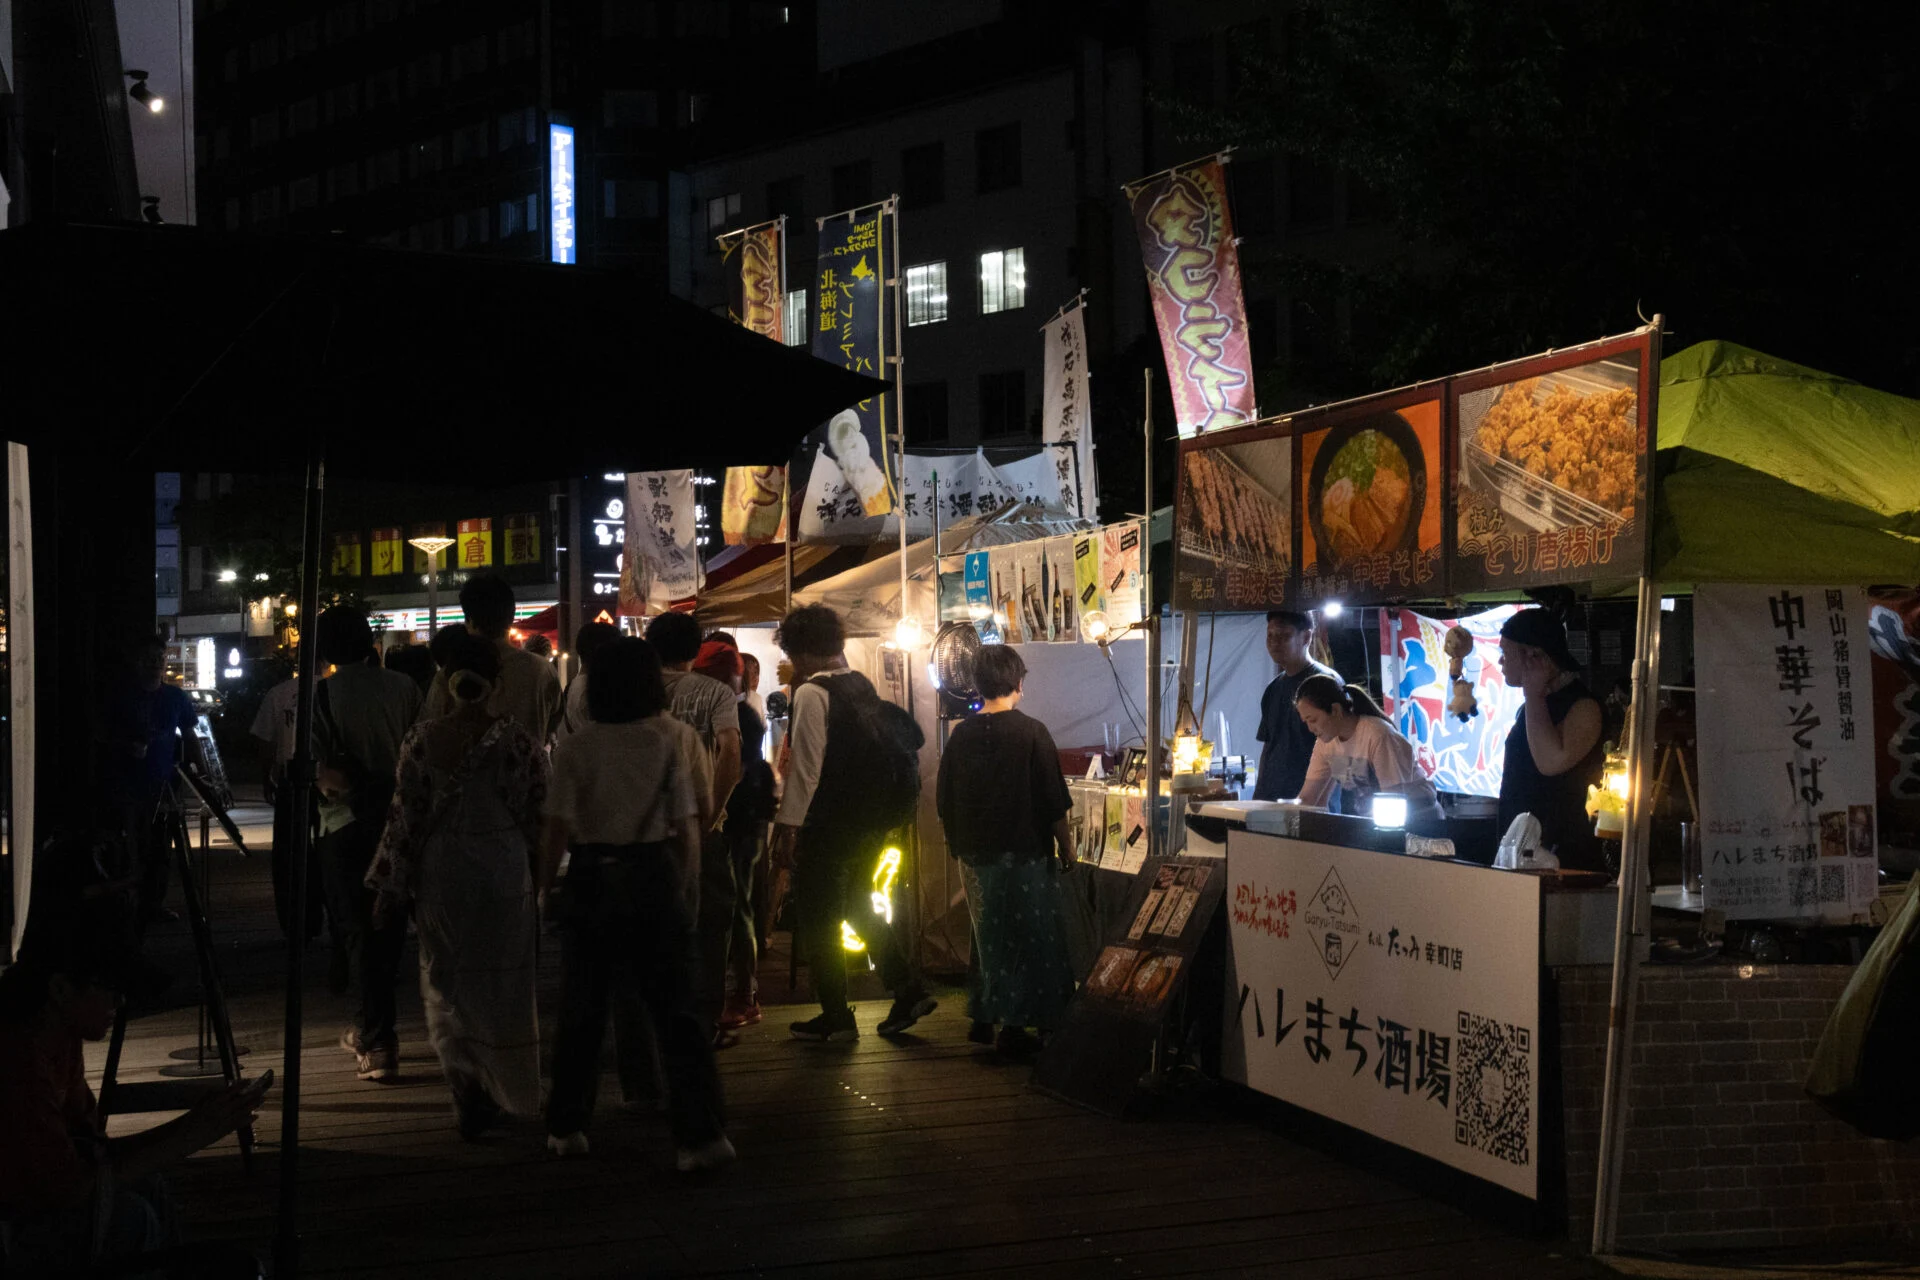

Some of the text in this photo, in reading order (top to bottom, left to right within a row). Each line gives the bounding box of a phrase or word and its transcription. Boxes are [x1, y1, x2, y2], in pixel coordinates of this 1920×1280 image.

[552, 131, 573, 264] アートネイチャー
[1469, 506, 1504, 537] 極み
[1484, 519, 1619, 576] とり唐揚げ
[1225, 566, 1287, 606] 串焼き
[1353, 548, 1434, 592] 中華そば
[1824, 588, 1855, 741] 岡山猪骨醤油
[1768, 589, 1827, 807] 中華そば
[1712, 842, 1818, 866] ハレまち酒場
[1304, 910, 1361, 936] Garyu-Tatsumi
[1425, 941, 1463, 972] 幸町店
[1233, 983, 1451, 1110] ハレまち酒場
